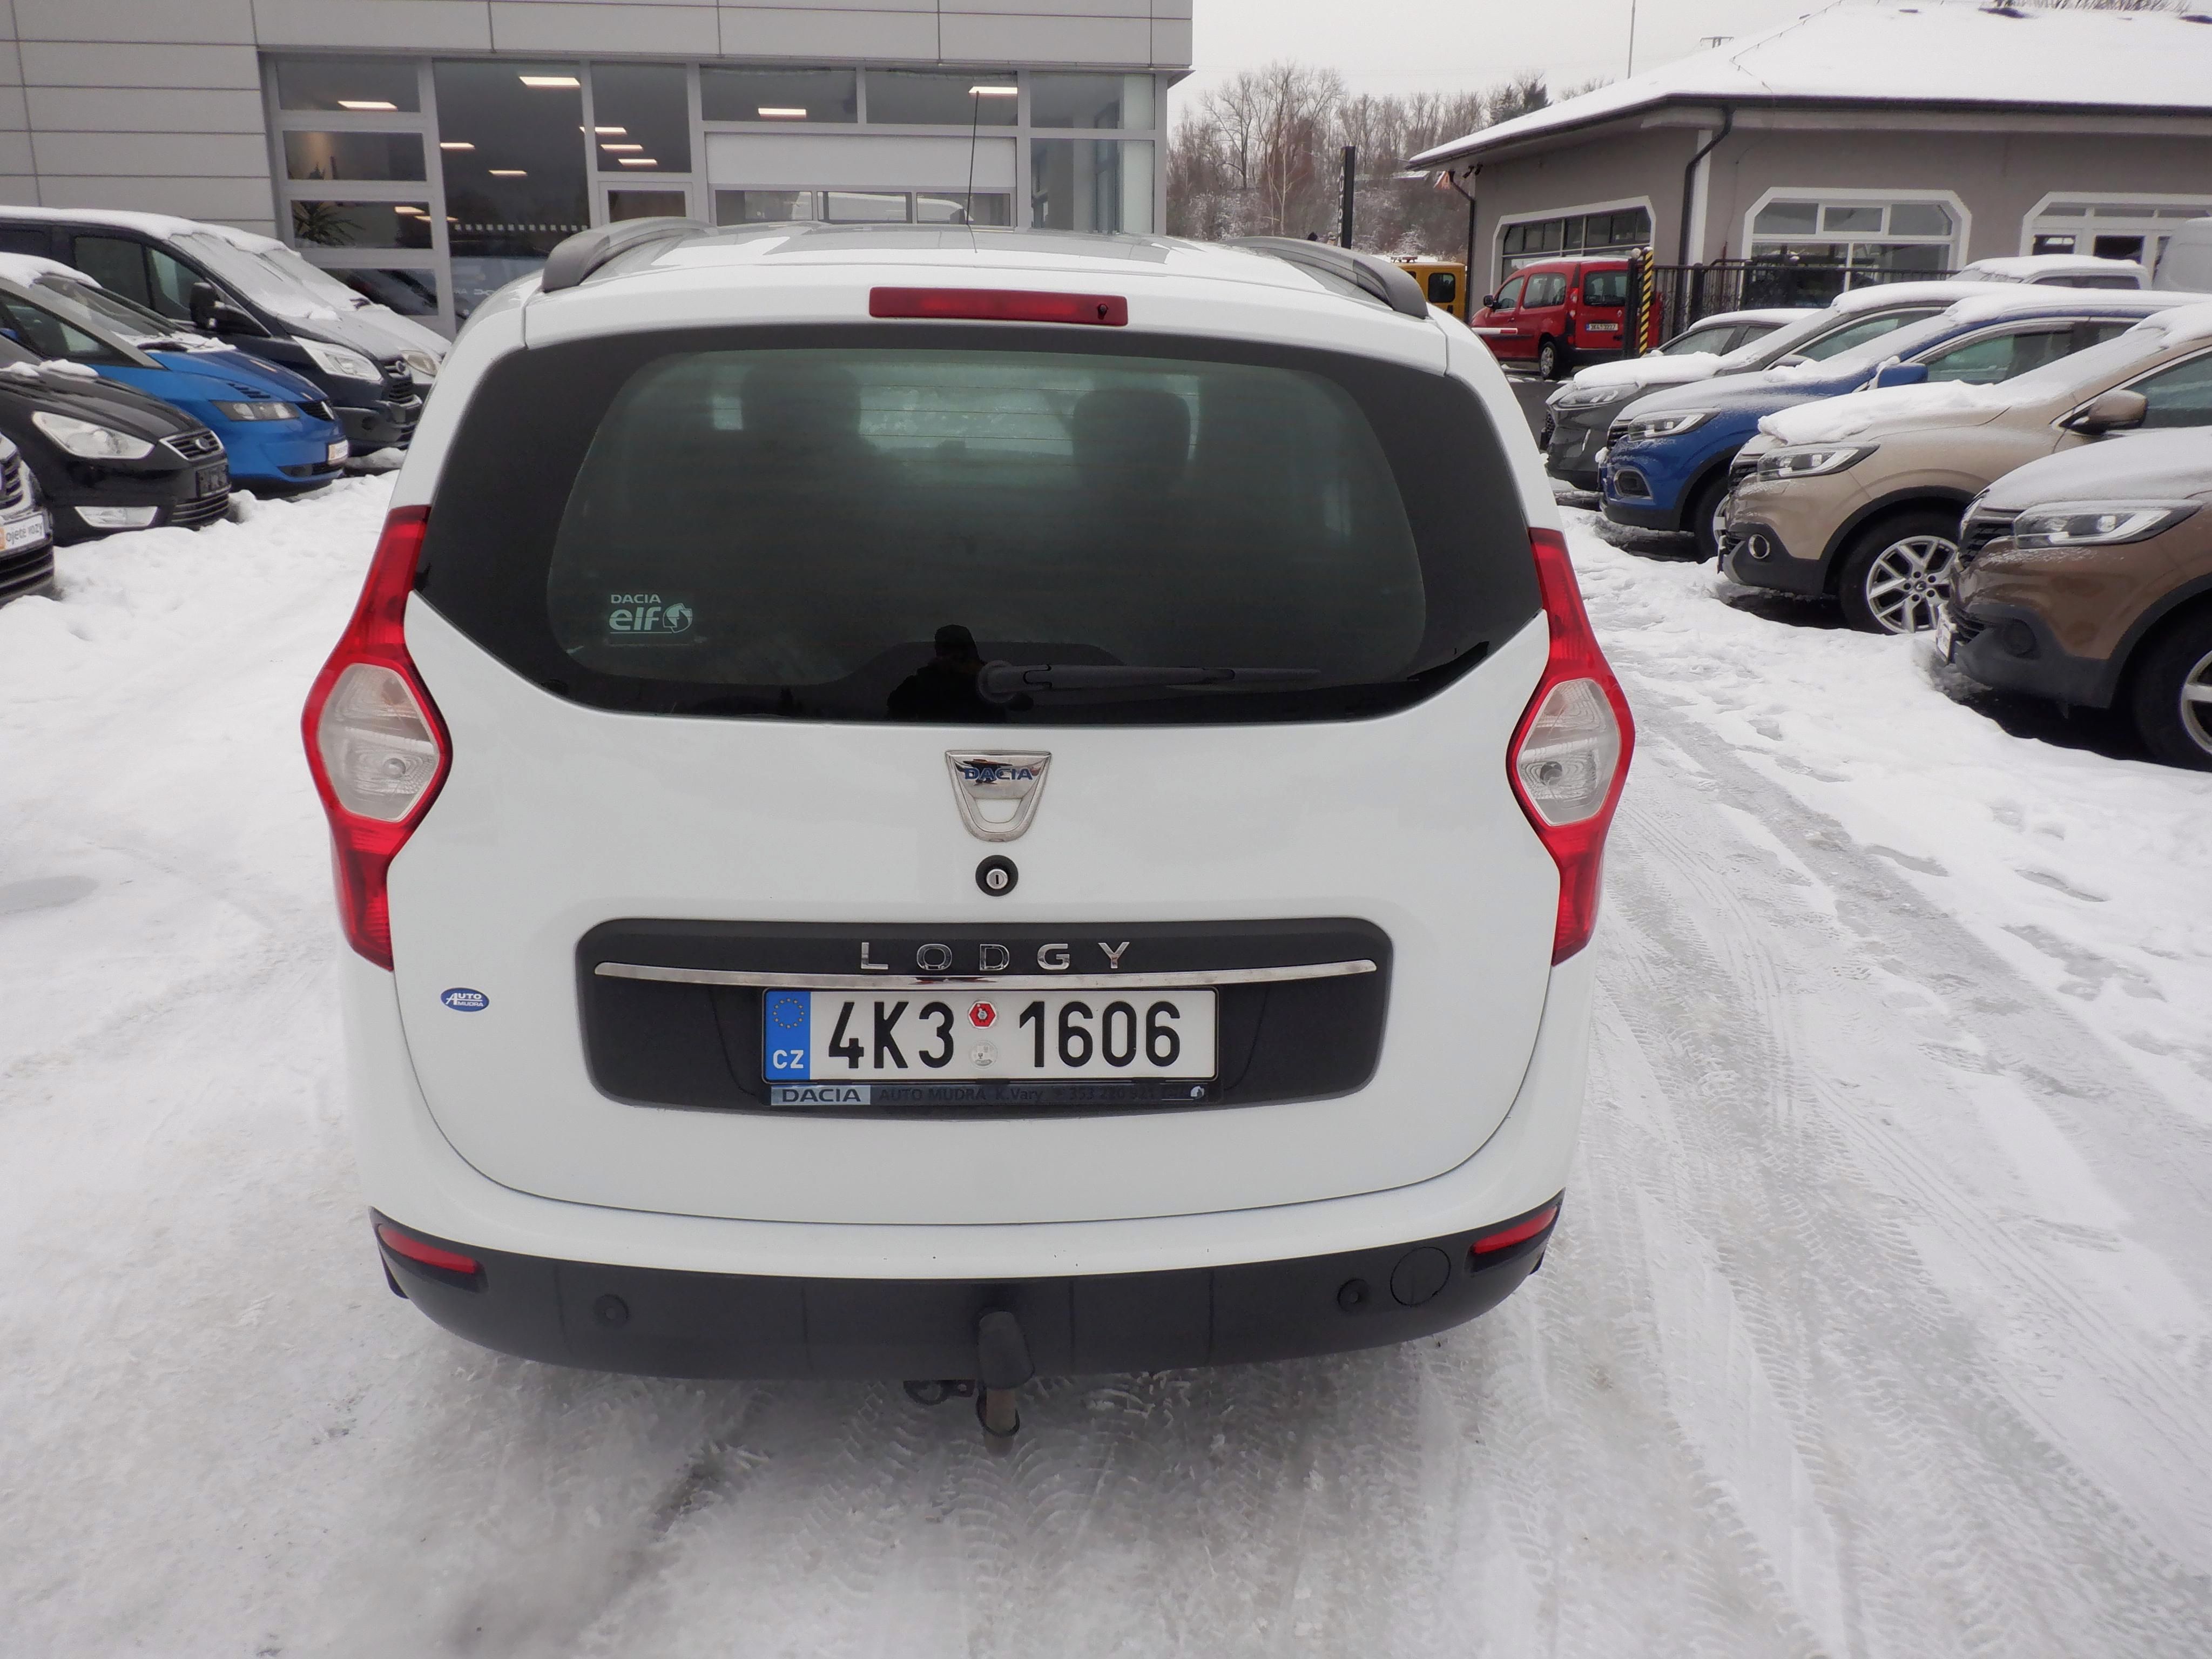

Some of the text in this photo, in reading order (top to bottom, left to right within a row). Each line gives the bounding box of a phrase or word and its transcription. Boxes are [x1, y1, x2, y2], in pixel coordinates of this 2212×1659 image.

[611, 594, 661, 604] DACIA
[609, 606, 662, 630] elf
[964, 767, 1033, 780] DACIA
[861, 942, 1130, 971] LODGY
[446, 993, 482, 1005] AUTO
[828, 1001, 1181, 1068] 4K3 1606
[773, 1049, 804, 1068] CZ
[782, 1088, 861, 1102] DACIA
[878, 1088, 923, 1101] AUTO
[929, 1088, 987, 1101] MUDRA
